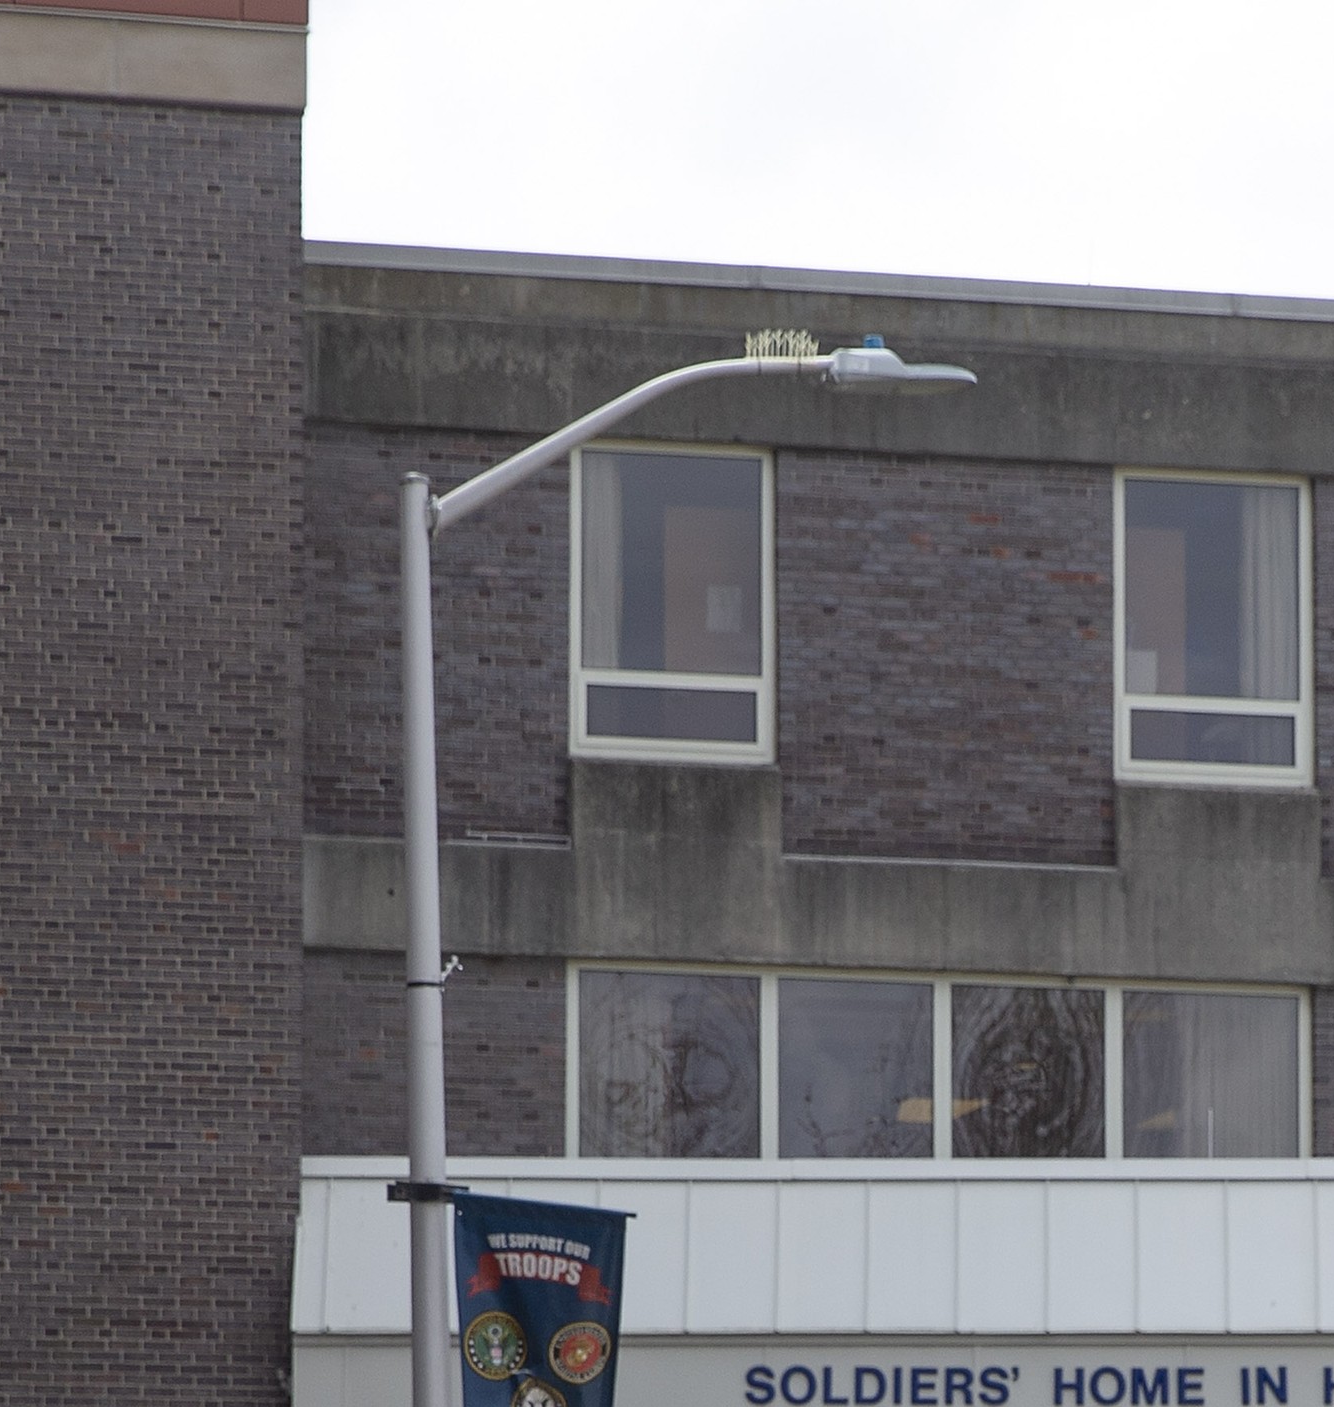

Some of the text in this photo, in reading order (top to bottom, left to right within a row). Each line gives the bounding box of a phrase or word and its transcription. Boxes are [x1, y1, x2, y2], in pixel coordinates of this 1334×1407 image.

[508, 1232, 564, 1253] SUPPORT
[564, 1240, 591, 1260] OUR
[494, 1252, 582, 1286] TROOPS
[744, 1365, 1020, 1407] SOLDIERS'
[1053, 1366, 1205, 1407] HOME
[1240, 1366, 1288, 1407] IN
